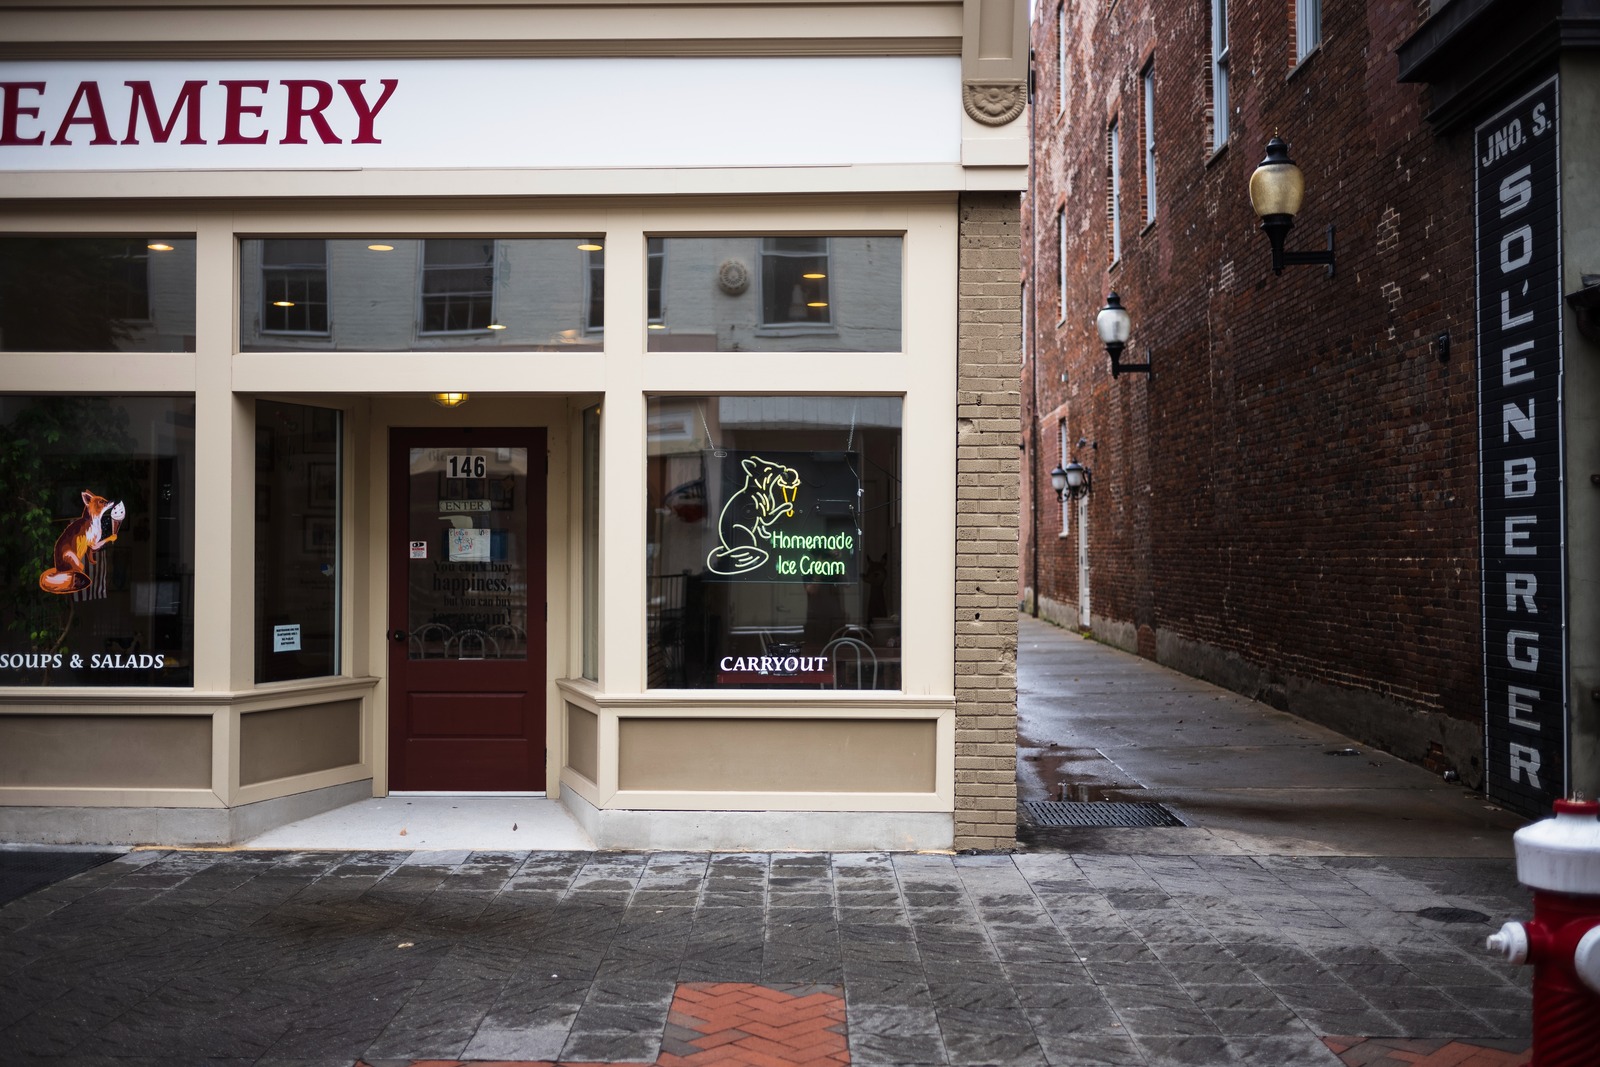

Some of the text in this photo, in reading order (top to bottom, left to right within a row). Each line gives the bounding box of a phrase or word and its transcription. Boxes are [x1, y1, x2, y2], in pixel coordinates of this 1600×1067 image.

[0, 79, 399, 146] EAMERY
[1482, 102, 1552, 167] JNO. S.
[449, 456, 485, 478] 146
[445, 501, 485, 511] ENTER
[773, 531, 853, 550] Homemade
[433, 560, 454, 572] You
[491, 561, 512, 575] buy
[778, 556, 845, 575] Ice Cream
[433, 573, 512, 596] happiness,
[0, 653, 165, 669] SOUPS & SALADS
[720, 656, 828, 672] CARRYOUT
